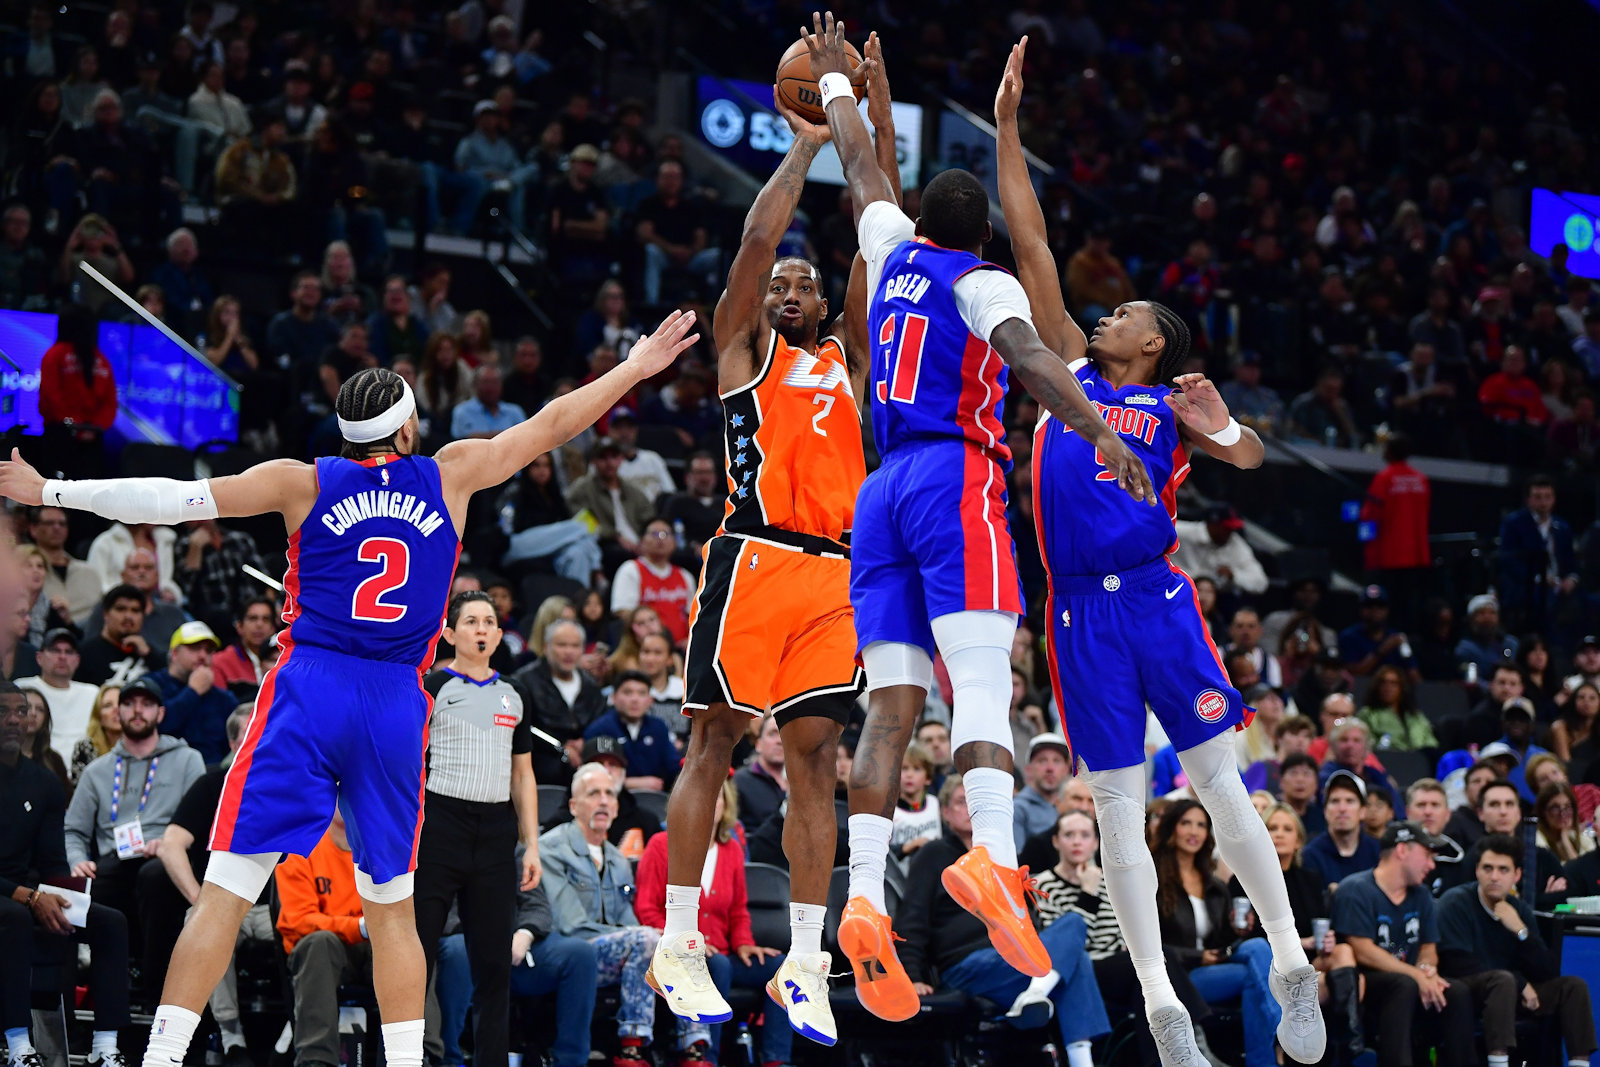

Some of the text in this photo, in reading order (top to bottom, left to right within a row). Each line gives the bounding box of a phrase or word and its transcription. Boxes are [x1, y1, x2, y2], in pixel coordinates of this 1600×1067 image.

[884, 273, 932, 304] GREEN
[876, 312, 929, 404] 31
[812, 393, 836, 437] 2
[321, 490, 445, 538] CUNNINGHAM
[351, 536, 410, 623] 2
